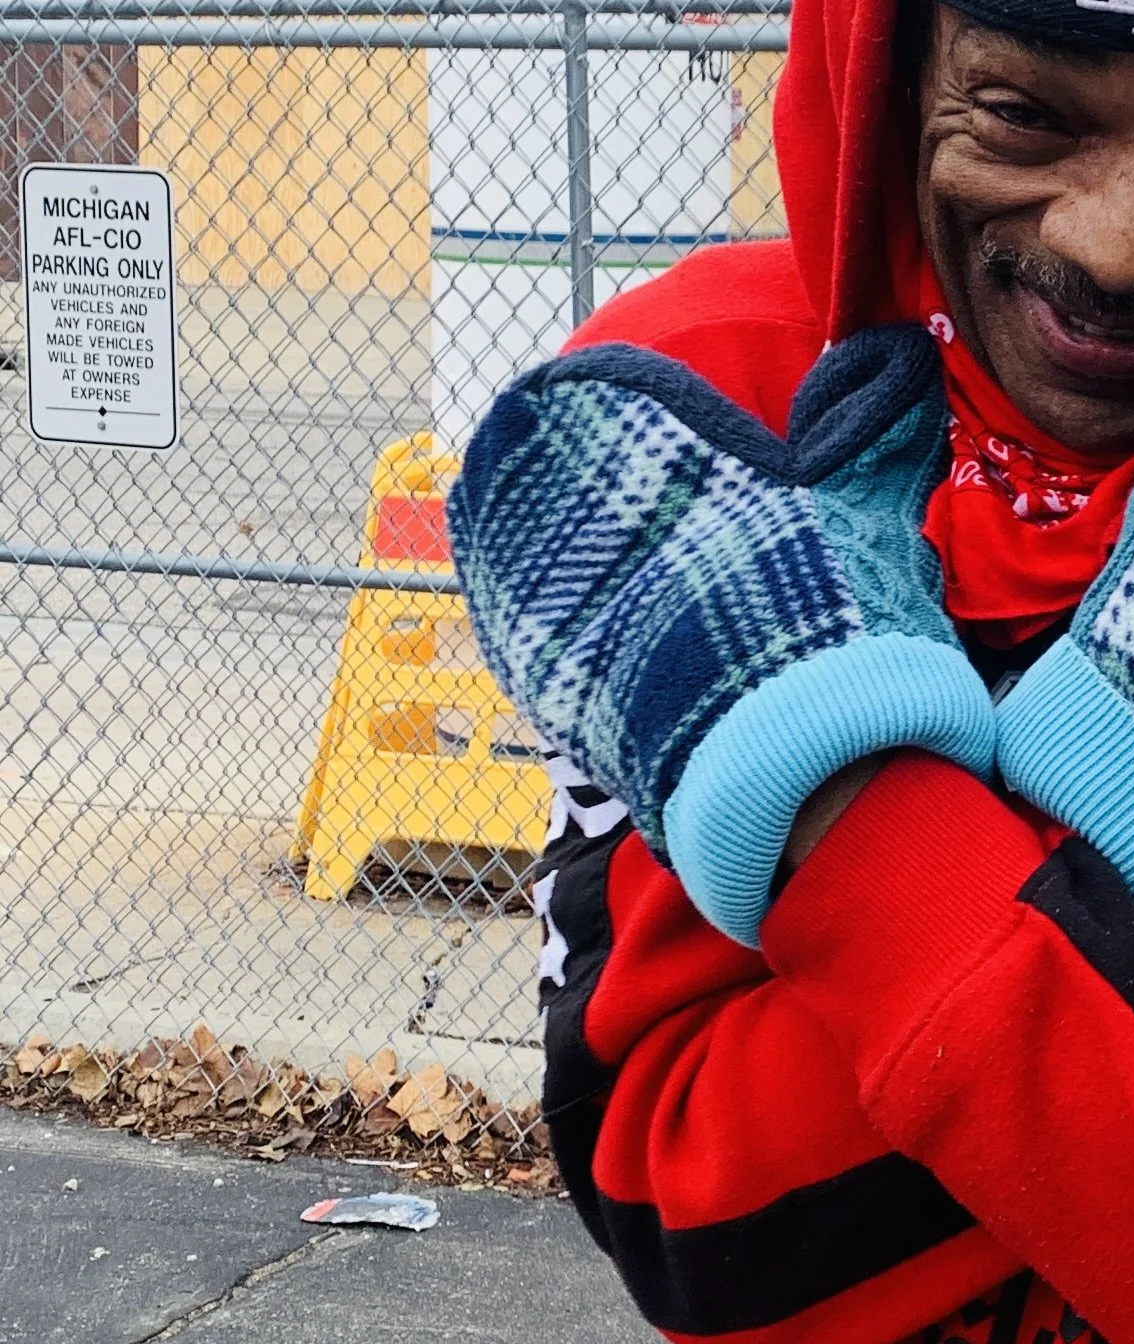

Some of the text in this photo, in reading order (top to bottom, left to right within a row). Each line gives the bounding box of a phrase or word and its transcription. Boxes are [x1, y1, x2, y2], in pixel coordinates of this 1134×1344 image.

[43, 197, 150, 221] MICHIGAN
[53, 226, 142, 250] AFL-CIO
[32, 254, 164, 280] PARKING ONLY
[32, 281, 166, 300] ANY UNAUTHORIZED
[50, 299, 148, 316] VEHICLES AND
[55, 318, 145, 333] ANY FOREIGN
[46, 334, 154, 352] MADE VEHICLES
[48, 351, 154, 369] WILL BE TOWED
[62, 368, 140, 386] AT OWNERS
[71, 386, 132, 403] EXPENSE
